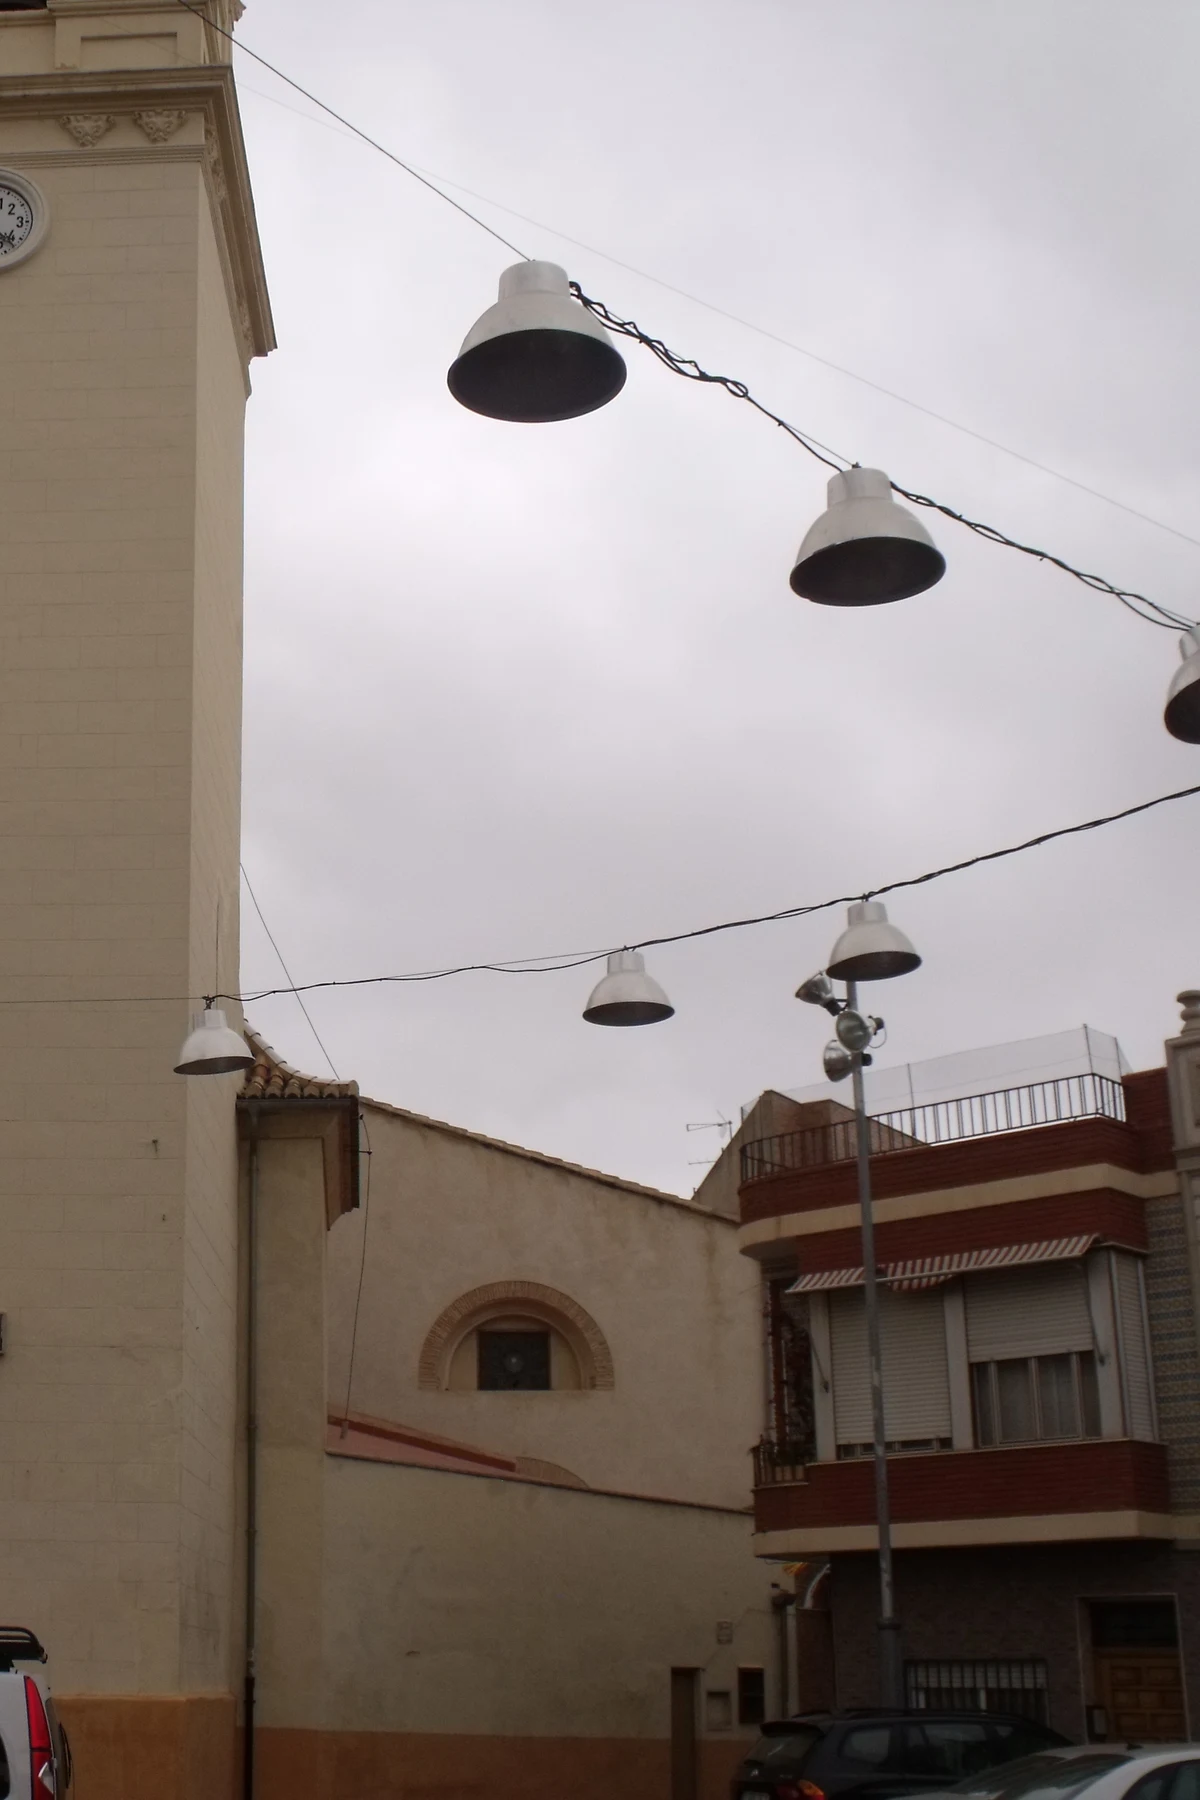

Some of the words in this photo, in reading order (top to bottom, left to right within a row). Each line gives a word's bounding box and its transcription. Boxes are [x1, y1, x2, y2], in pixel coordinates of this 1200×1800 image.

[0, 198, 3, 210] 1
[8, 203, 15, 215] 2
[16, 216, 24, 228] 3
[8, 230, 15, 242] 4
